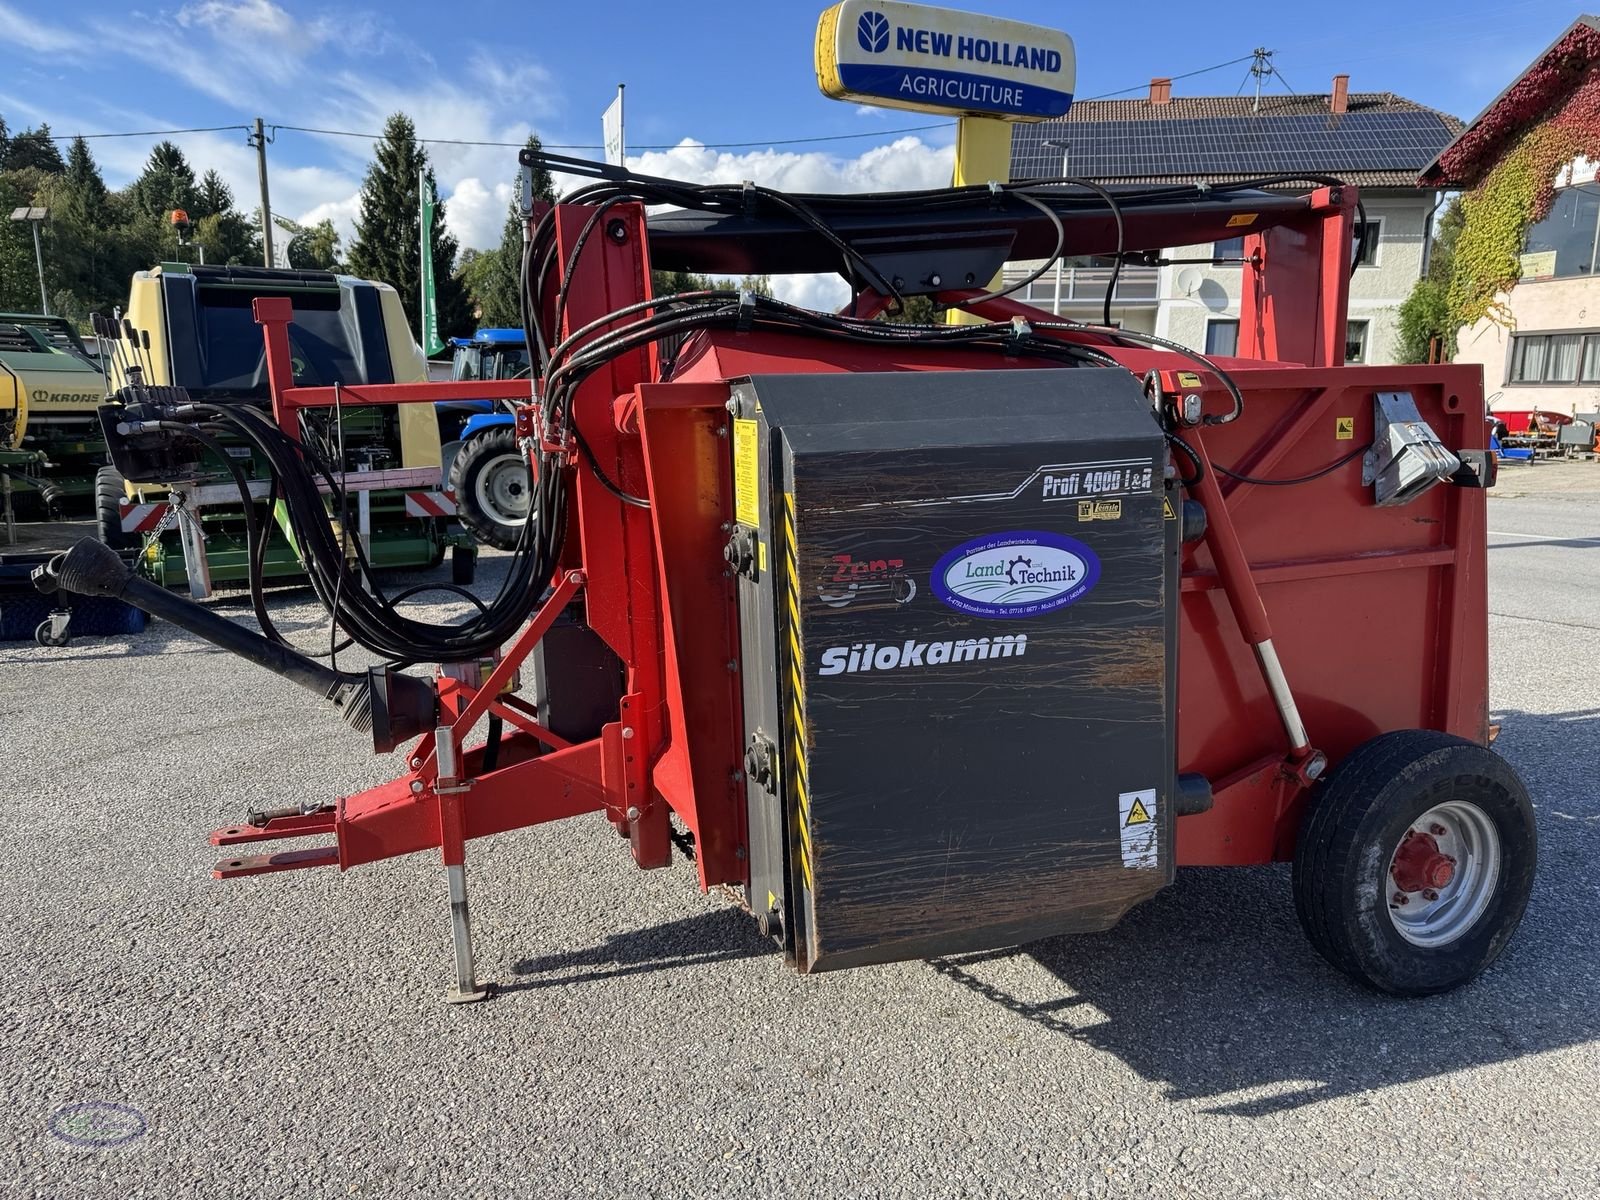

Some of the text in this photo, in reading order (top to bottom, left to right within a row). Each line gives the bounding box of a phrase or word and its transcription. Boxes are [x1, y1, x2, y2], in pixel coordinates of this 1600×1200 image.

[897, 27, 1061, 73] NEW HOLLAND
[900, 74, 1023, 107] AGRICULTURE
[50, 393, 100, 403] KRONE
[1042, 473, 1080, 497] Profi
[965, 545, 986, 556] Partner
[997, 538, 1038, 547] Landwirtschaft
[965, 559, 1005, 578] Land
[1018, 565, 1076, 585] Technik
[1041, 600, 1056, 610] Mobil
[818, 633, 1028, 676] Silokamm
